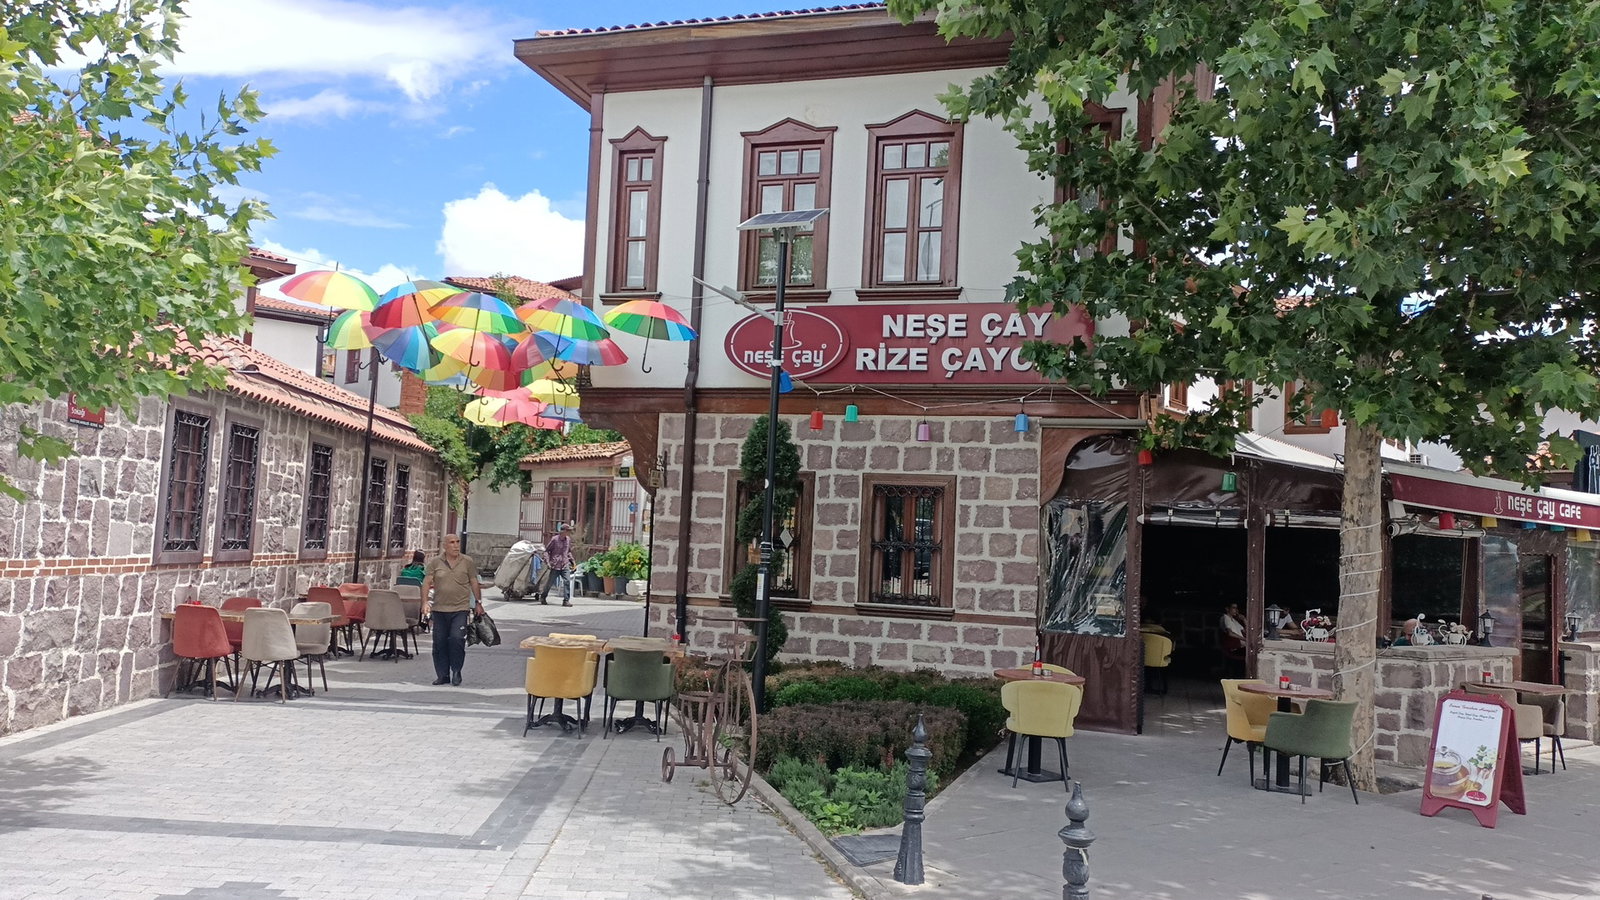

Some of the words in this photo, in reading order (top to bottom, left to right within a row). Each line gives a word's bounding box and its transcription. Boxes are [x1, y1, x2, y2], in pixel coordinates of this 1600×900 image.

[882, 314, 967, 343] NEŞE
[980, 313, 1053, 343] ÇAY
[856, 342, 929, 371] RİZE
